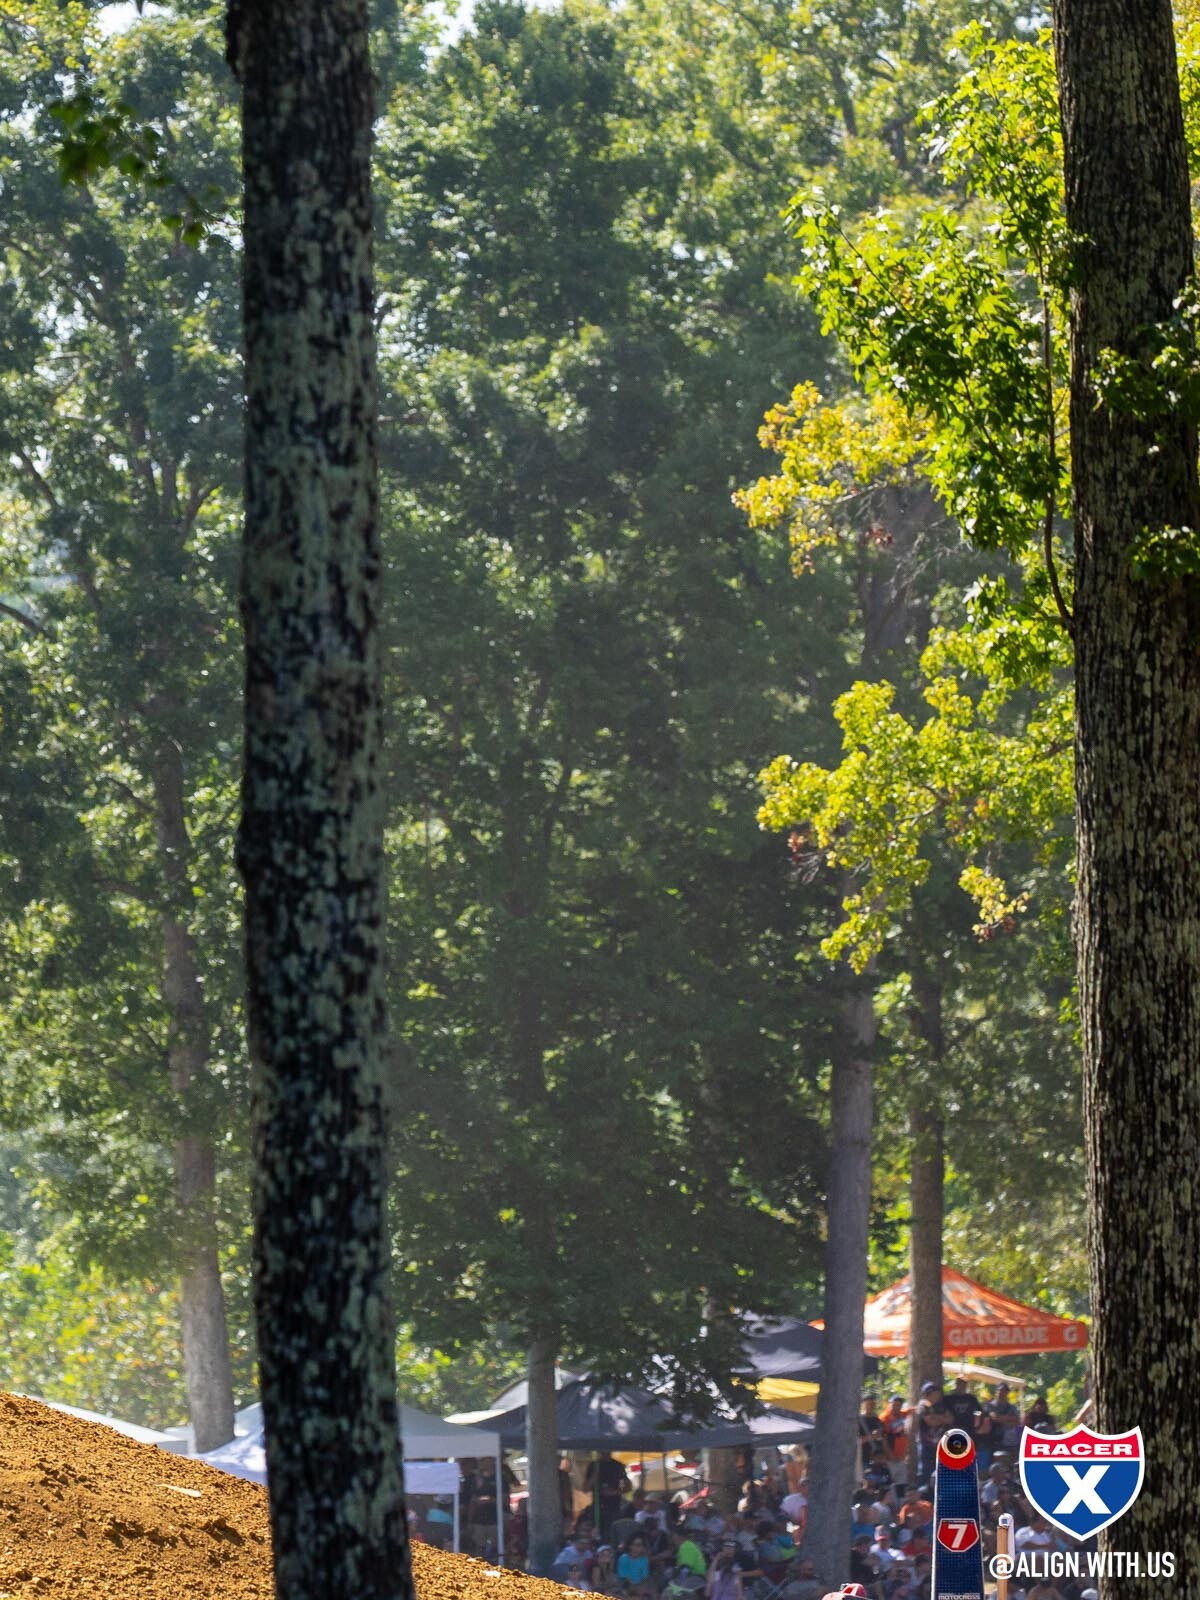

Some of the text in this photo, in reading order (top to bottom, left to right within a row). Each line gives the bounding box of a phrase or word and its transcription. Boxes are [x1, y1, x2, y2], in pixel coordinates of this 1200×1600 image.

[949, 1325, 1078, 1347] GATORADE G
[948, 1523, 968, 1549] 7
